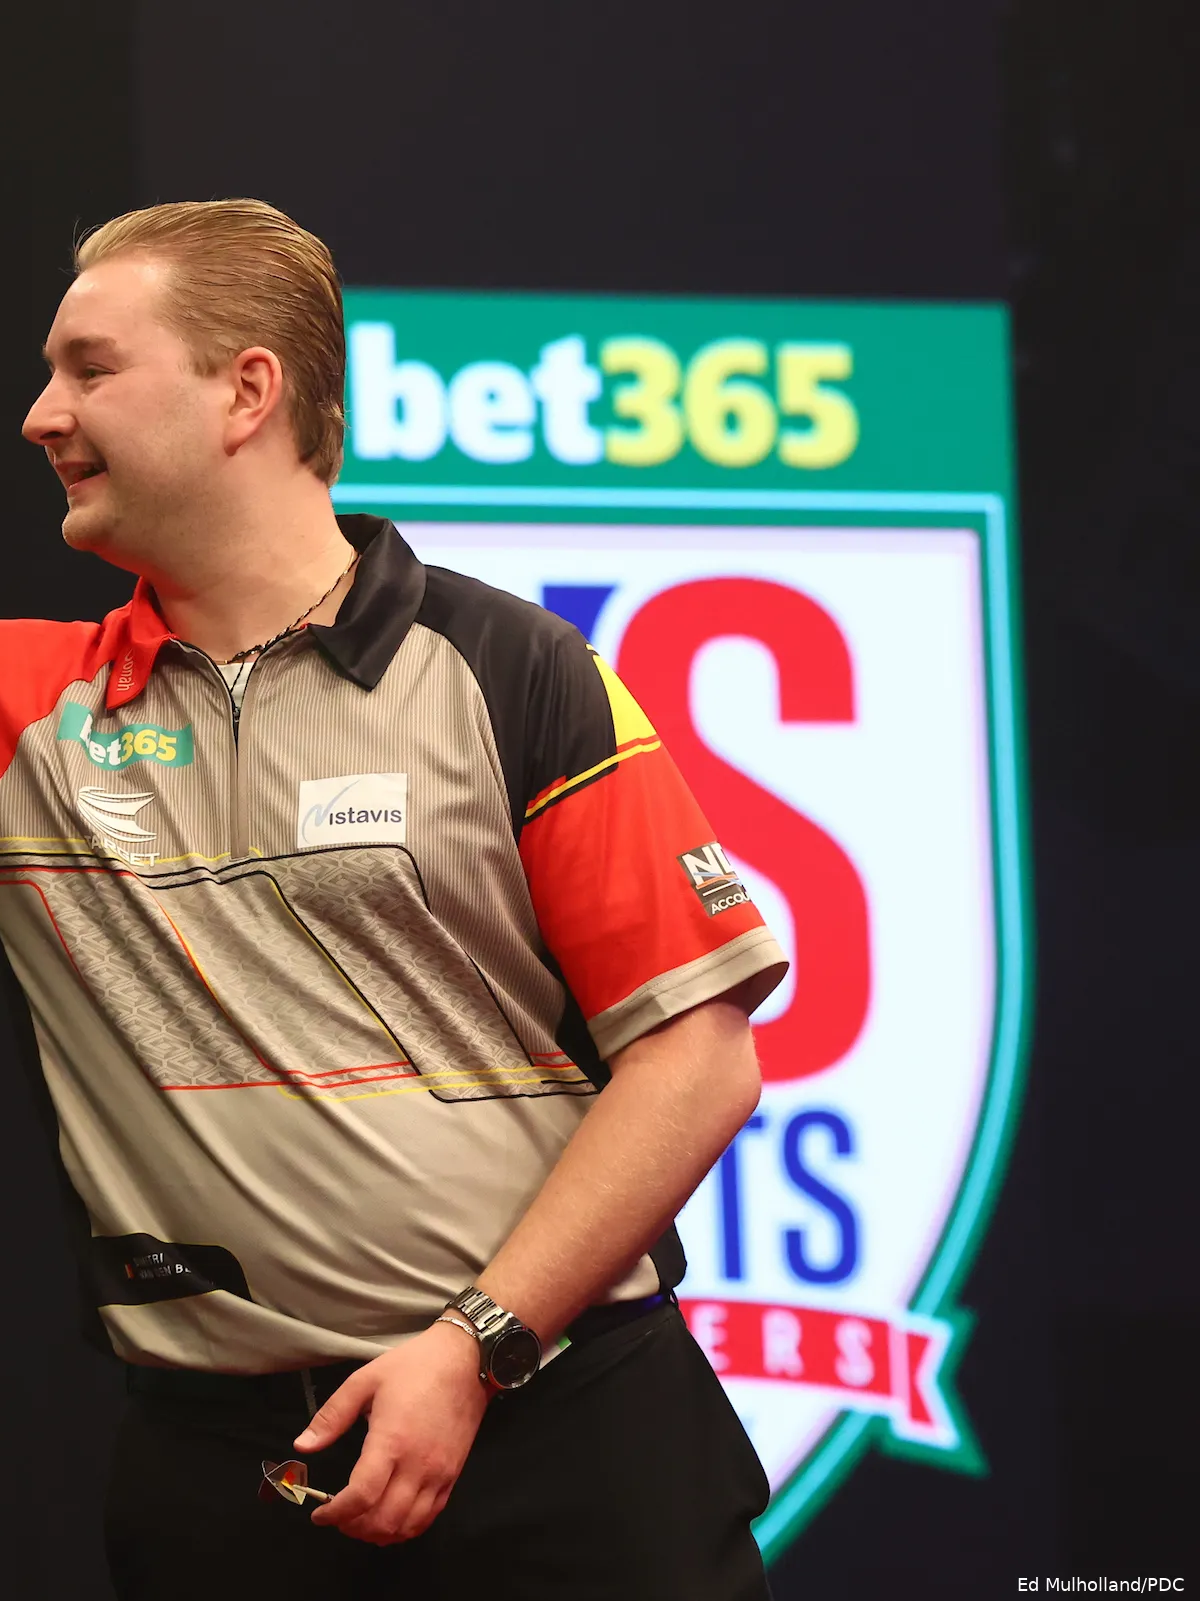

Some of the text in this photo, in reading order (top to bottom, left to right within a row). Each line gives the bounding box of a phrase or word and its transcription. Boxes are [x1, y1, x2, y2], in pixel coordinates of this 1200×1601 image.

[349, 321, 858, 469] bet365
[80, 713, 177, 766] bet365
[540, 573, 873, 1083] S
[711, 891, 751, 914] ACCOU
[718, 1110, 858, 1285] TS
[690, 1303, 876, 1387] ERS
